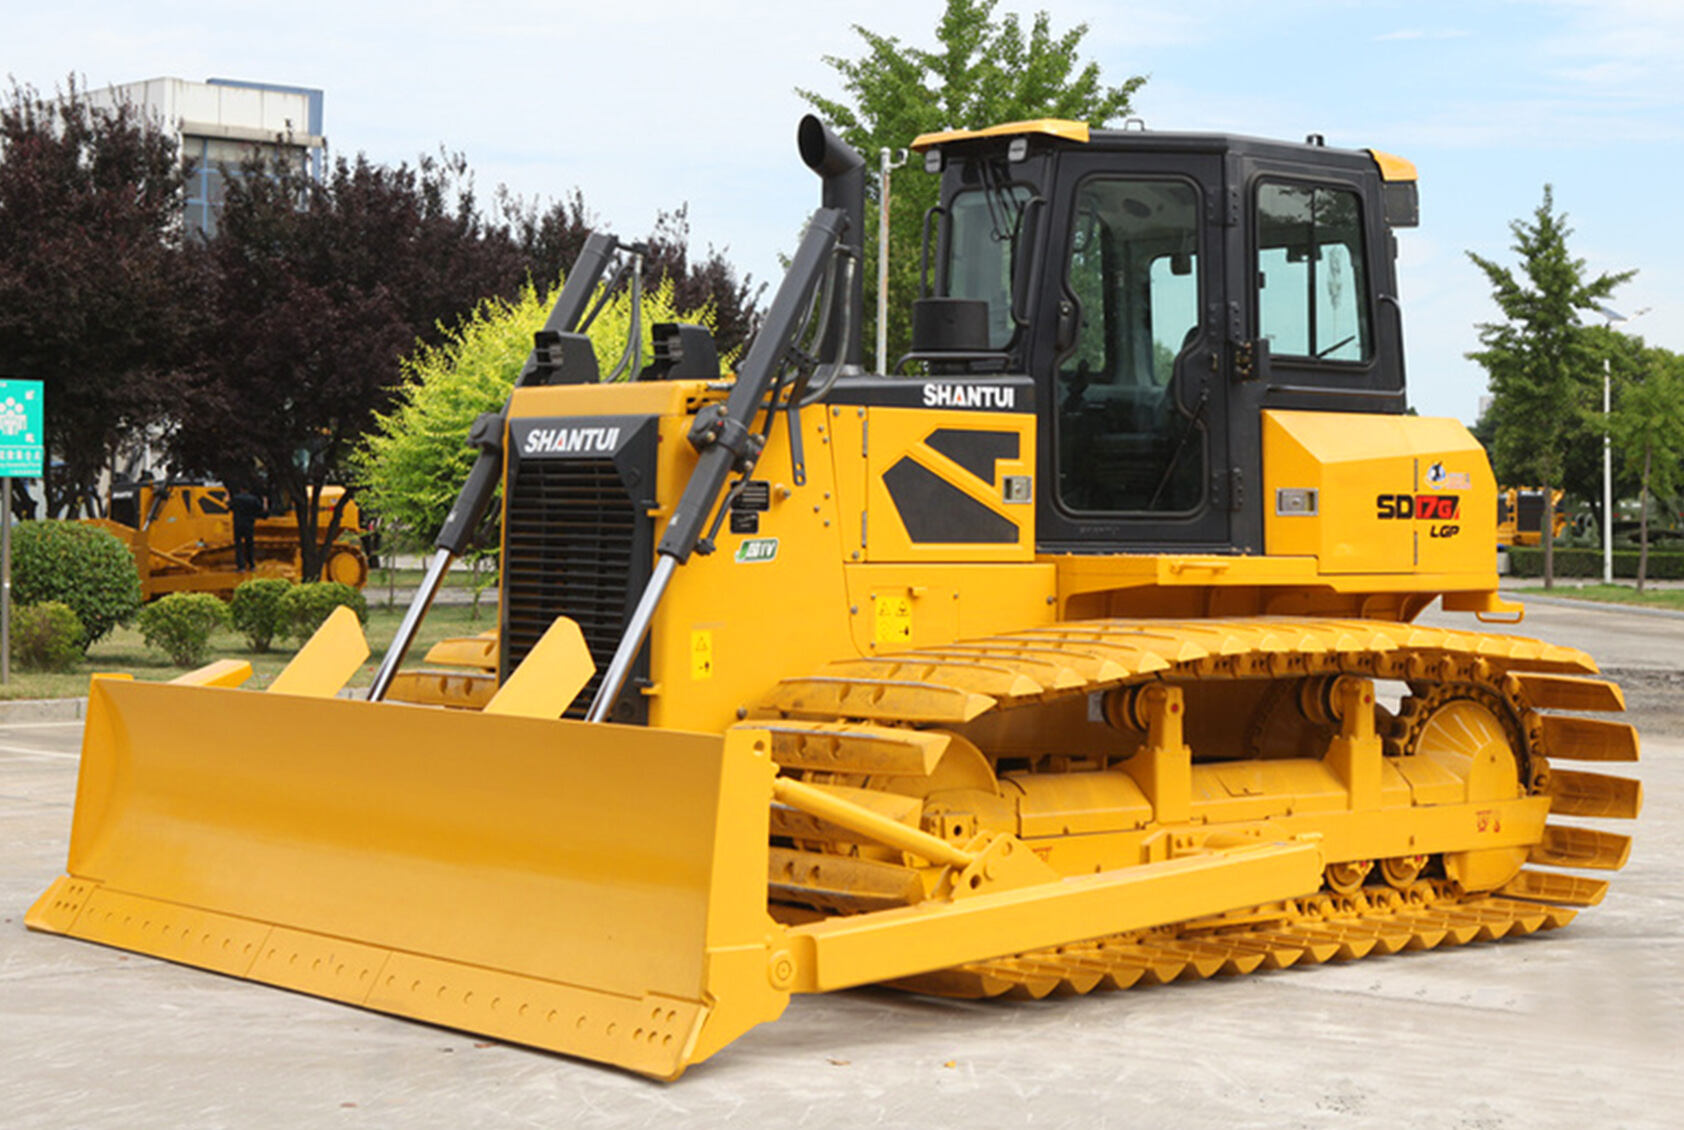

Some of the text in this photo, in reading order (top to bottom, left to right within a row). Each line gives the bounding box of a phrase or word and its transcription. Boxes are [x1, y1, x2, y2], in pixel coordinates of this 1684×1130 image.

[923, 383, 1015, 408] SHANTUI
[524, 427, 620, 453] SHANTUI
[1377, 494, 1457, 520] SD17G
[1430, 524, 1460, 538] LGP
